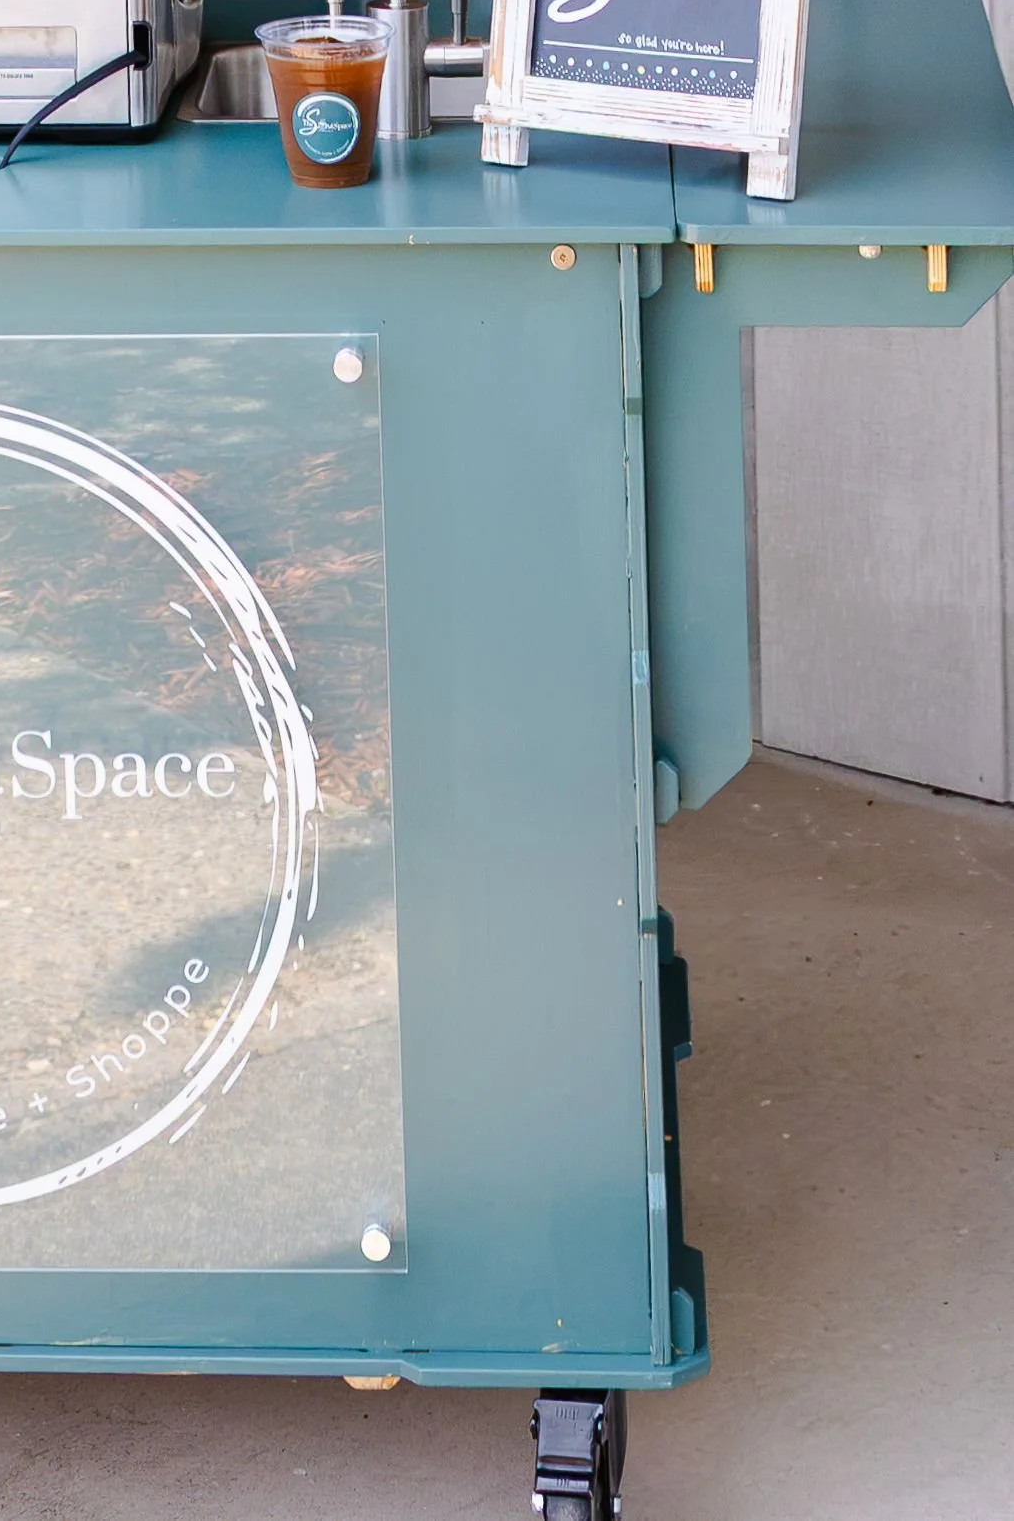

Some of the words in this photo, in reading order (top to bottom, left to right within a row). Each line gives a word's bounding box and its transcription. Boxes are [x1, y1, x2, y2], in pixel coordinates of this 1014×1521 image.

[617, 32, 632, 45] so
[634, 34, 658, 49] glad
[64, 956, 210, 1099] Shoppe
